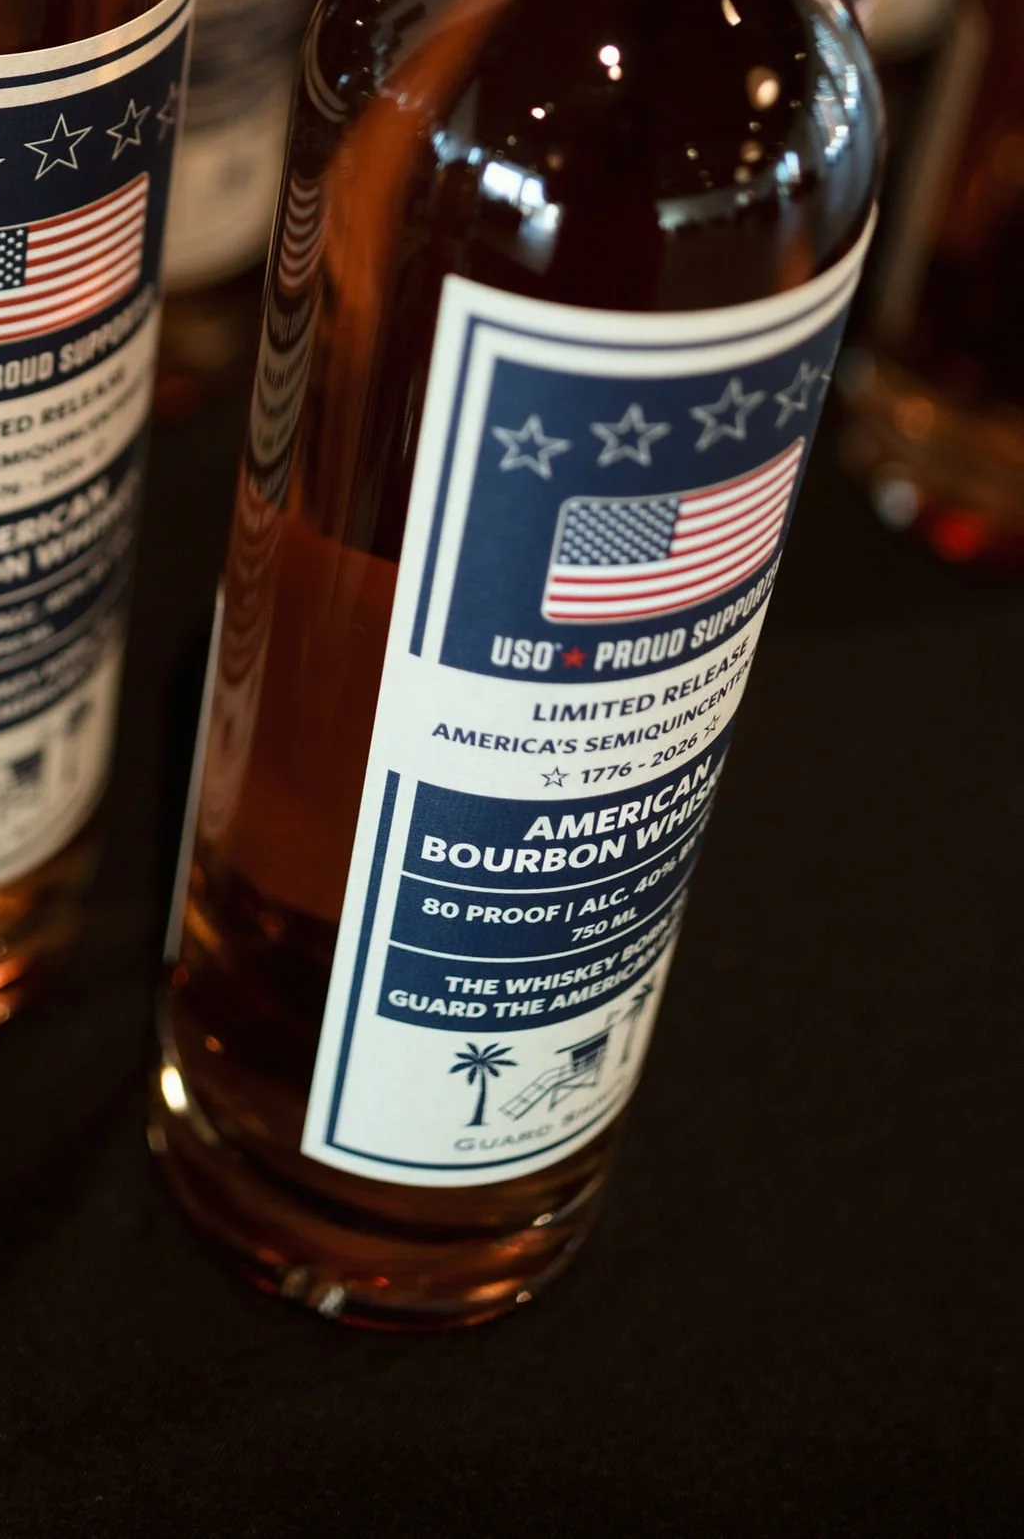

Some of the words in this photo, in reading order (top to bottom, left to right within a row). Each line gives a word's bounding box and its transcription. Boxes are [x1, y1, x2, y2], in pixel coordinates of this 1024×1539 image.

[491, 634, 554, 672] USO
[594, 627, 687, 672] PROUD
[532, 693, 655, 722] LIMITED
[662, 634, 751, 706] RELEASE
[432, 723, 577, 754] AMERICA'S
[580, 762, 632, 784] 1776
[649, 733, 698, 768] 2026
[523, 754, 713, 841] AMERICAN
[420, 834, 627, 873] BOURBON
[421, 897, 460, 919] 80
[465, 903, 561, 924] PROOF
[578, 887, 629, 916] ALC.
[634, 854, 676, 895] 40%
[571, 919, 607, 942] 750
[610, 906, 638, 929] ML
[444, 975, 500, 996] THE
[505, 951, 621, 996] WHISKEY
[388, 989, 487, 1019] GUARD
[492, 998, 546, 1019] THE
